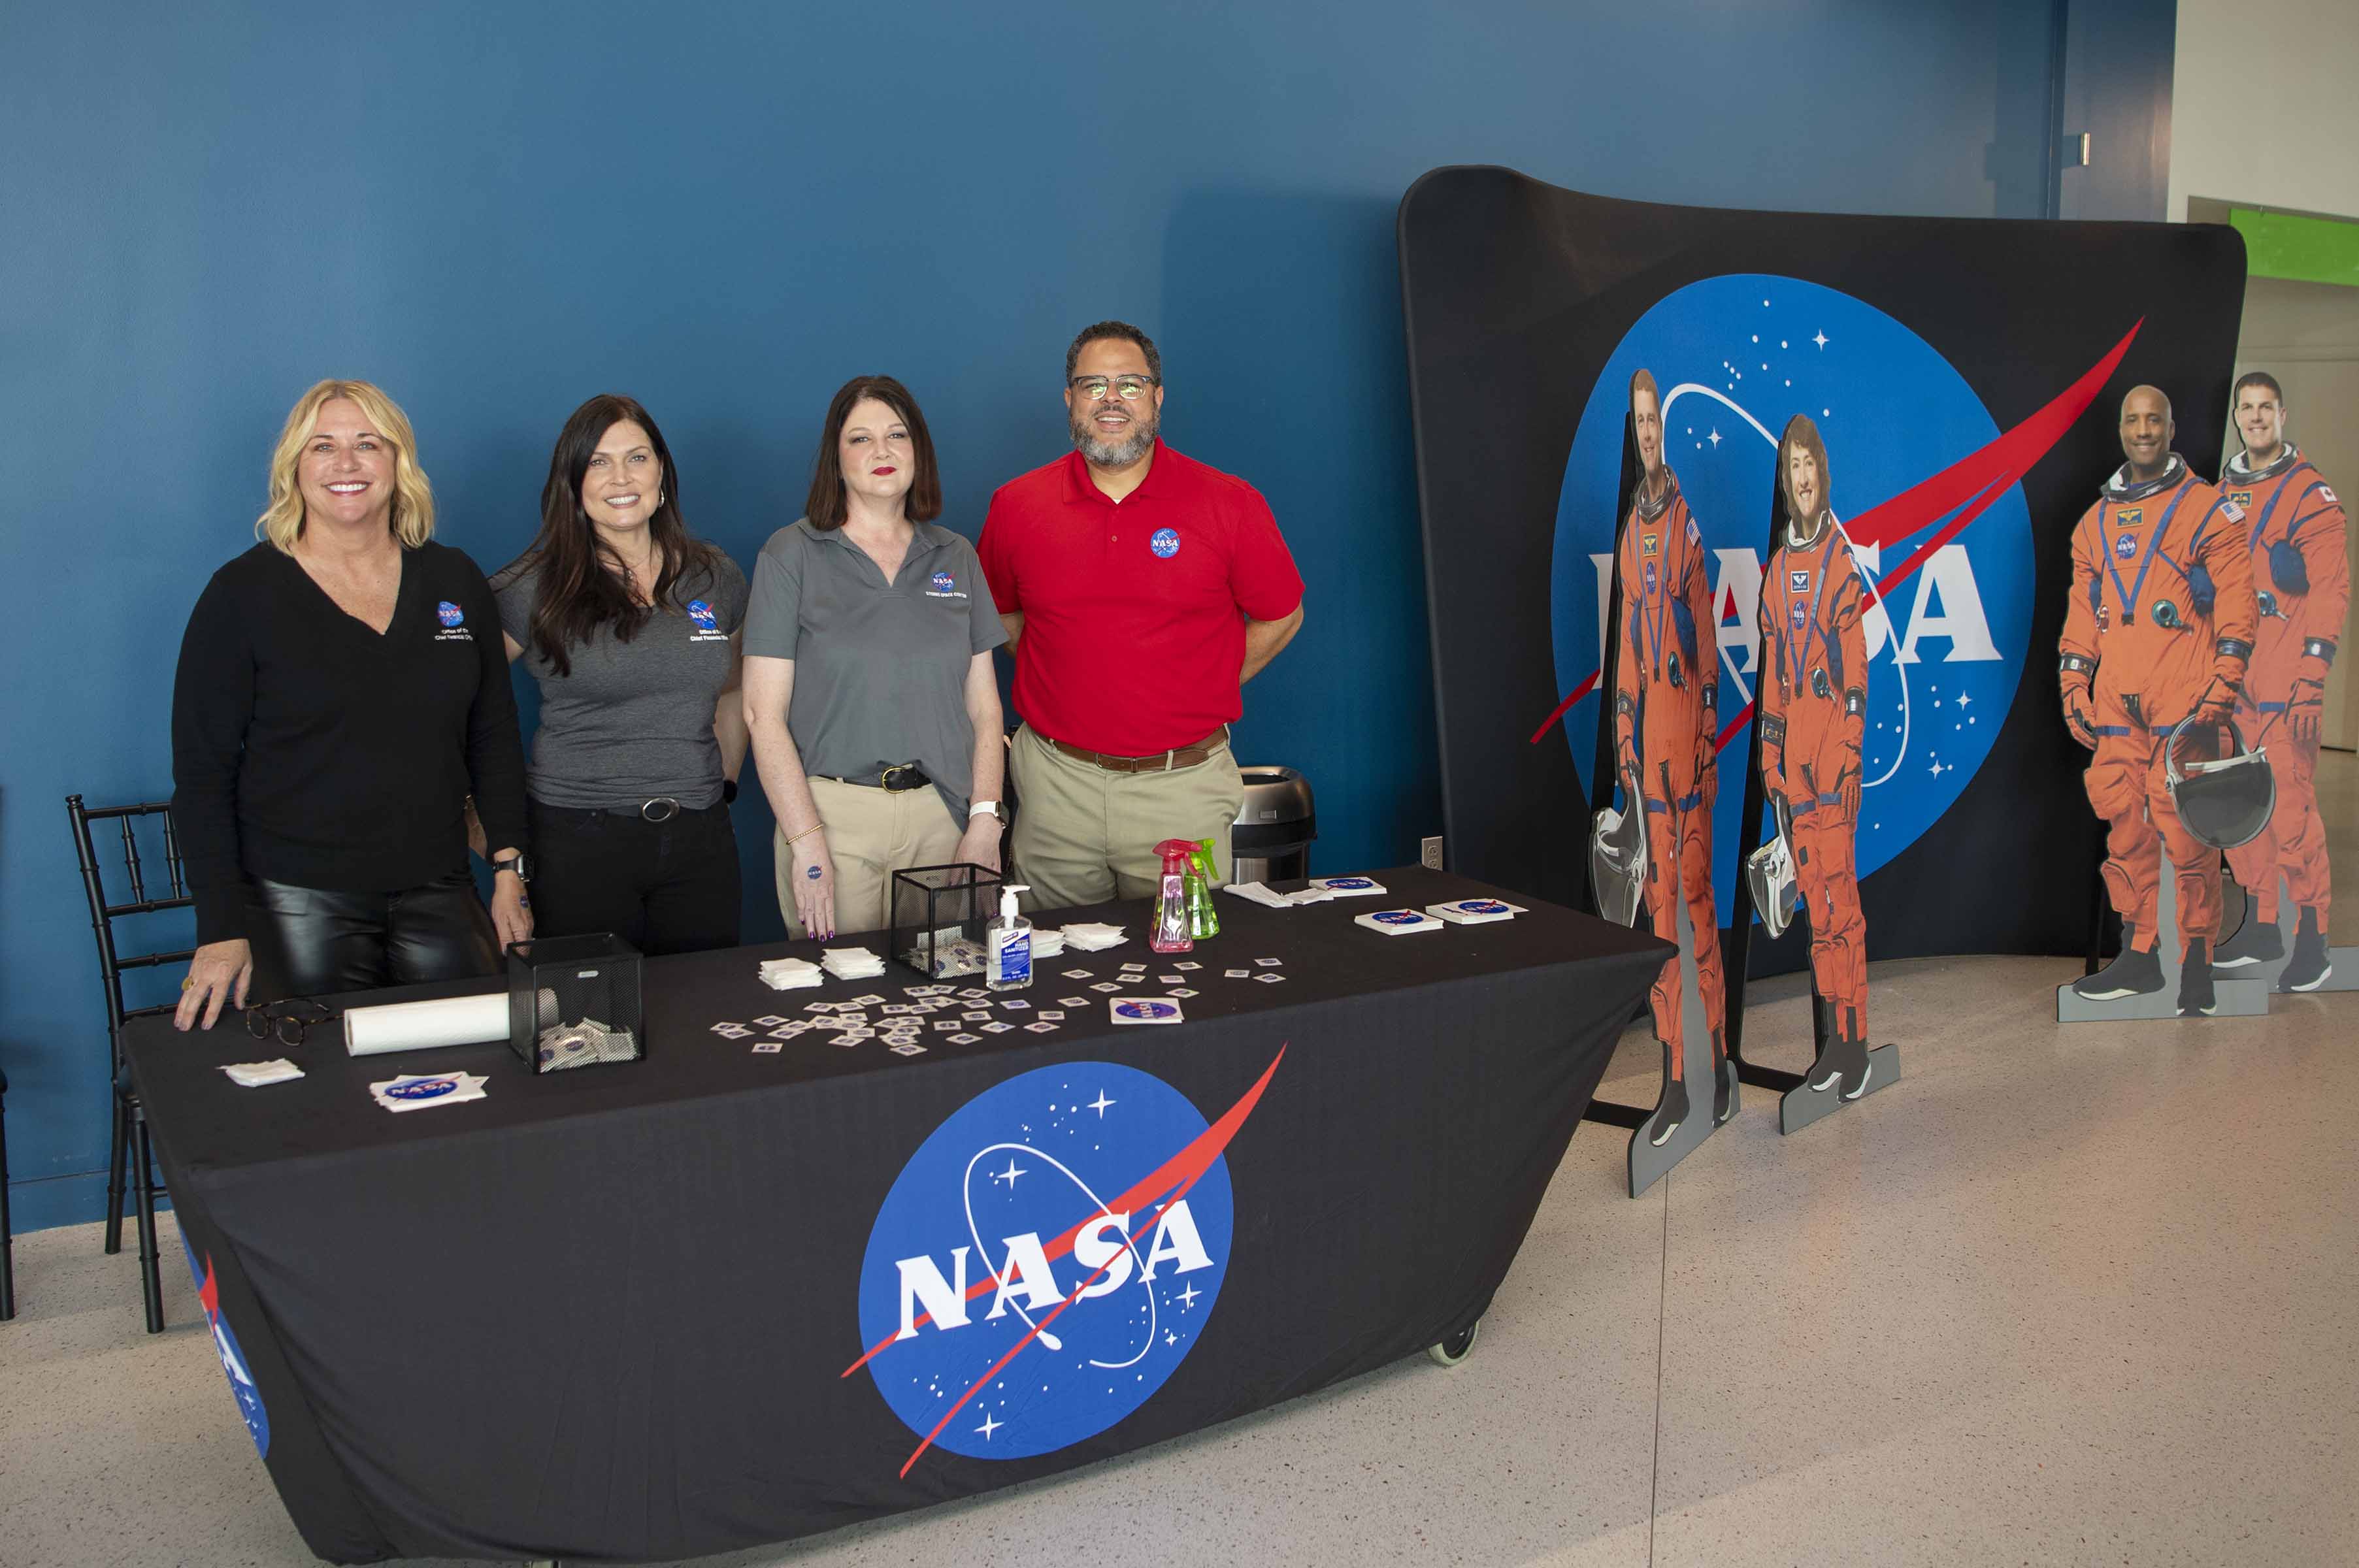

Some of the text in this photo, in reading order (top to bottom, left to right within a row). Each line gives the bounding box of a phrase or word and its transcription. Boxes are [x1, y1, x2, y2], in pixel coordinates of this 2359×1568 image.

[1589, 544, 2003, 689] AA
[1004, 945, 1029, 954] SANITIZER
[392, 1083, 453, 1096] NASA
[895, 1200, 1214, 1341] NASA
